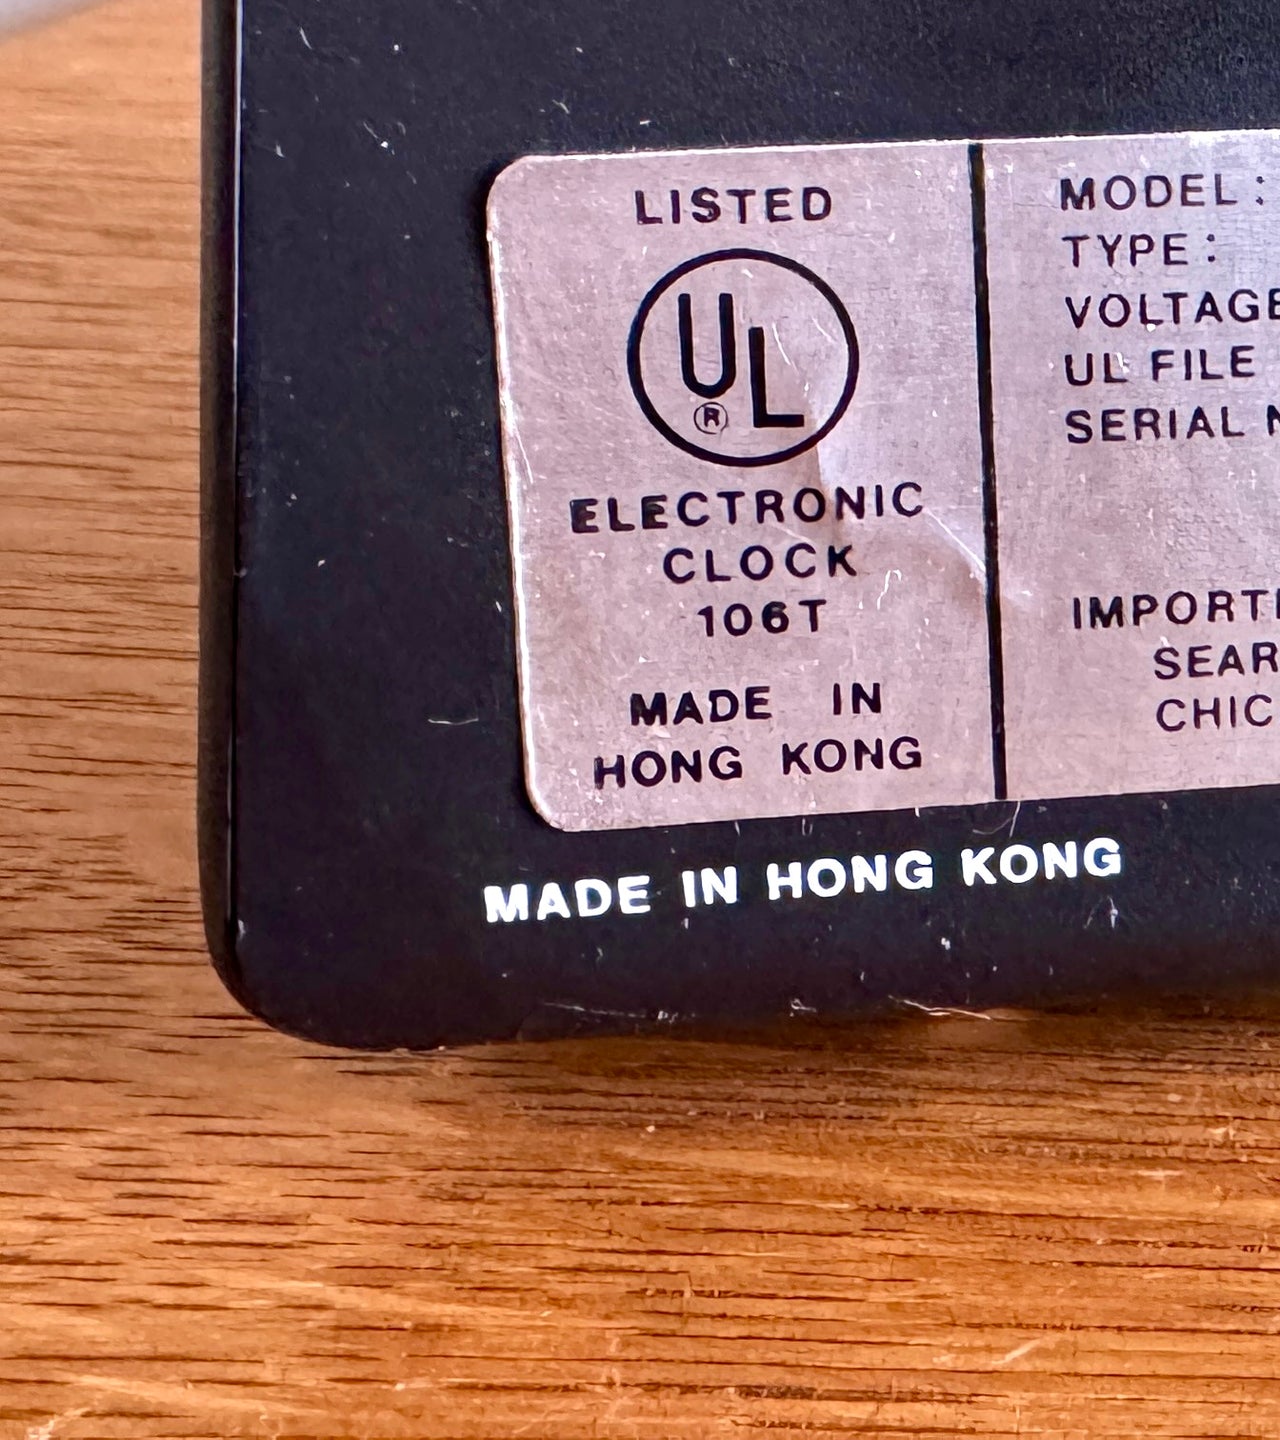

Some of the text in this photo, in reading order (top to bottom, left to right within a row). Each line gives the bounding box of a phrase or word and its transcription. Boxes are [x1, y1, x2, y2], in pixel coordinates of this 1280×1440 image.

[634, 186, 832, 225] LISTED
[1059, 173, 1265, 212] MODEL:
[1061, 232, 1216, 268] TYPE:
[676, 290, 806, 430] UL
[1064, 352, 1129, 387] UL
[1150, 345, 1256, 383] FILE
[1065, 405, 1245, 445] SERIAL
[569, 481, 923, 534] ELECTRONIC
[662, 542, 858, 585] CLOCK
[697, 598, 827, 638] 106T
[629, 682, 882, 727] MADE IN
[593, 735, 922, 791] HONG KONG
[483, 837, 1122, 923] MADE IN HONG KONG
